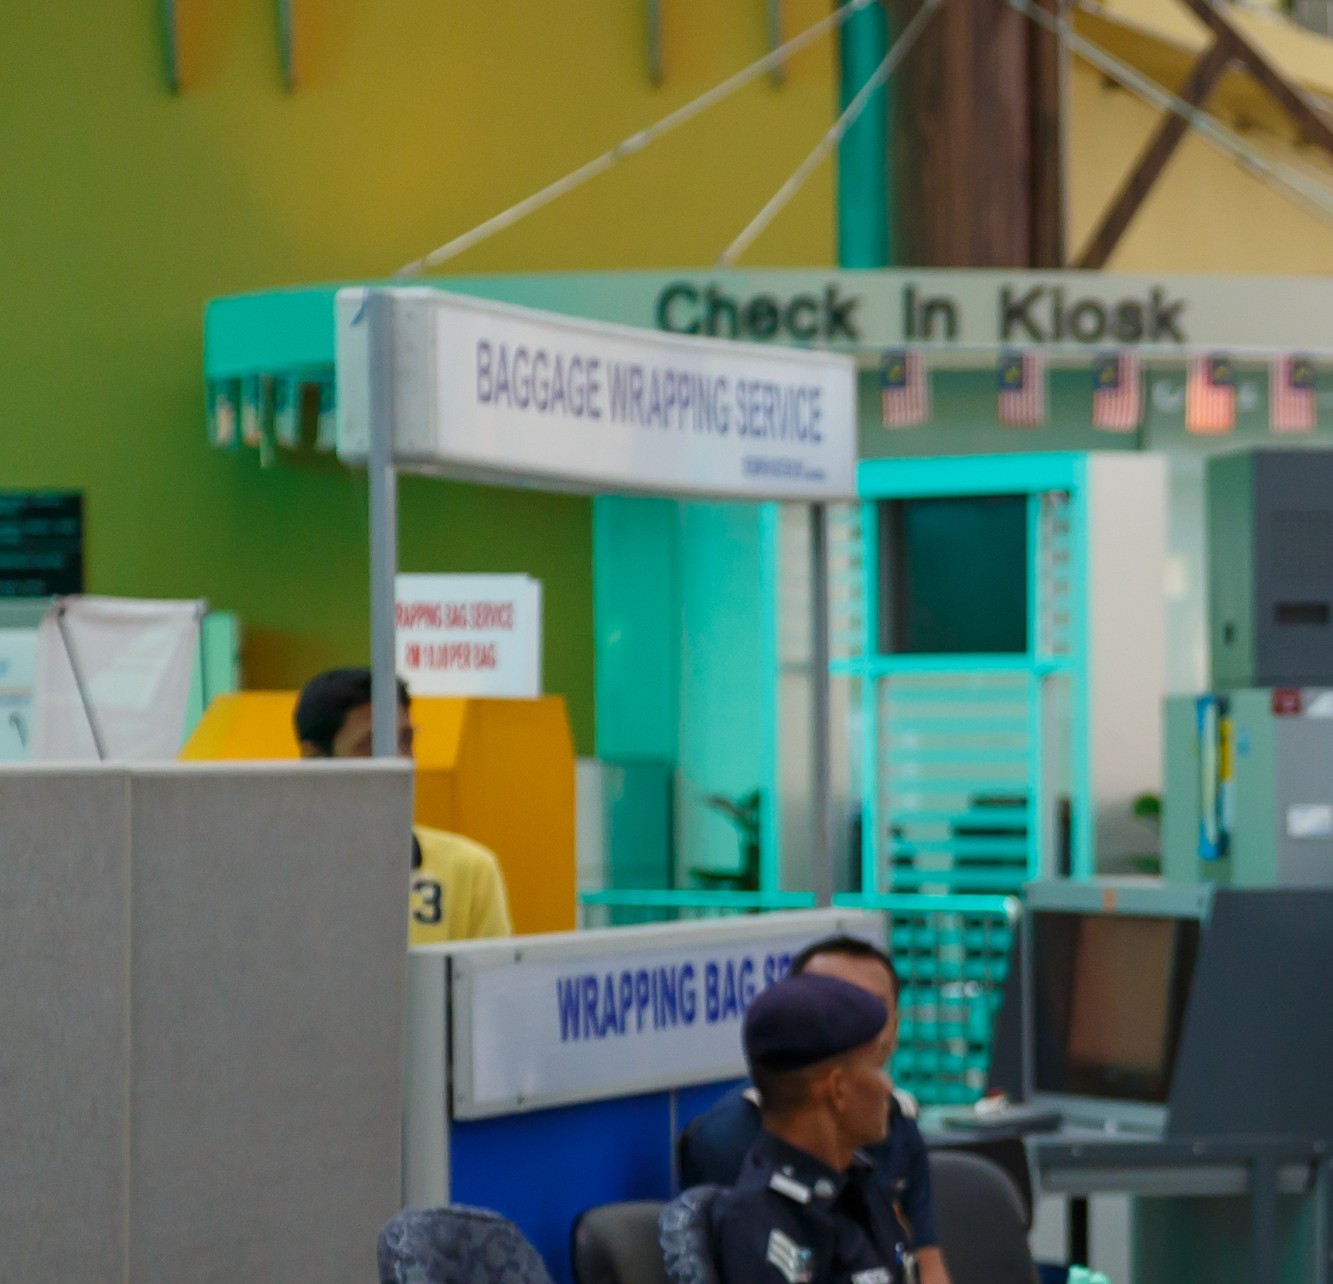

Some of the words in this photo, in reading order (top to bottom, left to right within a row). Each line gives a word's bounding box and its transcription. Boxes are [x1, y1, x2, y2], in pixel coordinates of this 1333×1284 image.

[655, 281, 861, 341] Check
[903, 284, 959, 341] In
[1001, 284, 1188, 343] Kiosk
[475, 338, 602, 420] BAGGAGE
[606, 358, 730, 437] WRAPPING
[735, 376, 824, 442] SERVICE
[396, 601, 441, 629] RAPPING
[413, 880, 443, 925] 3
[556, 962, 695, 1042] WRAPPING
[704, 956, 755, 1022] BAG
